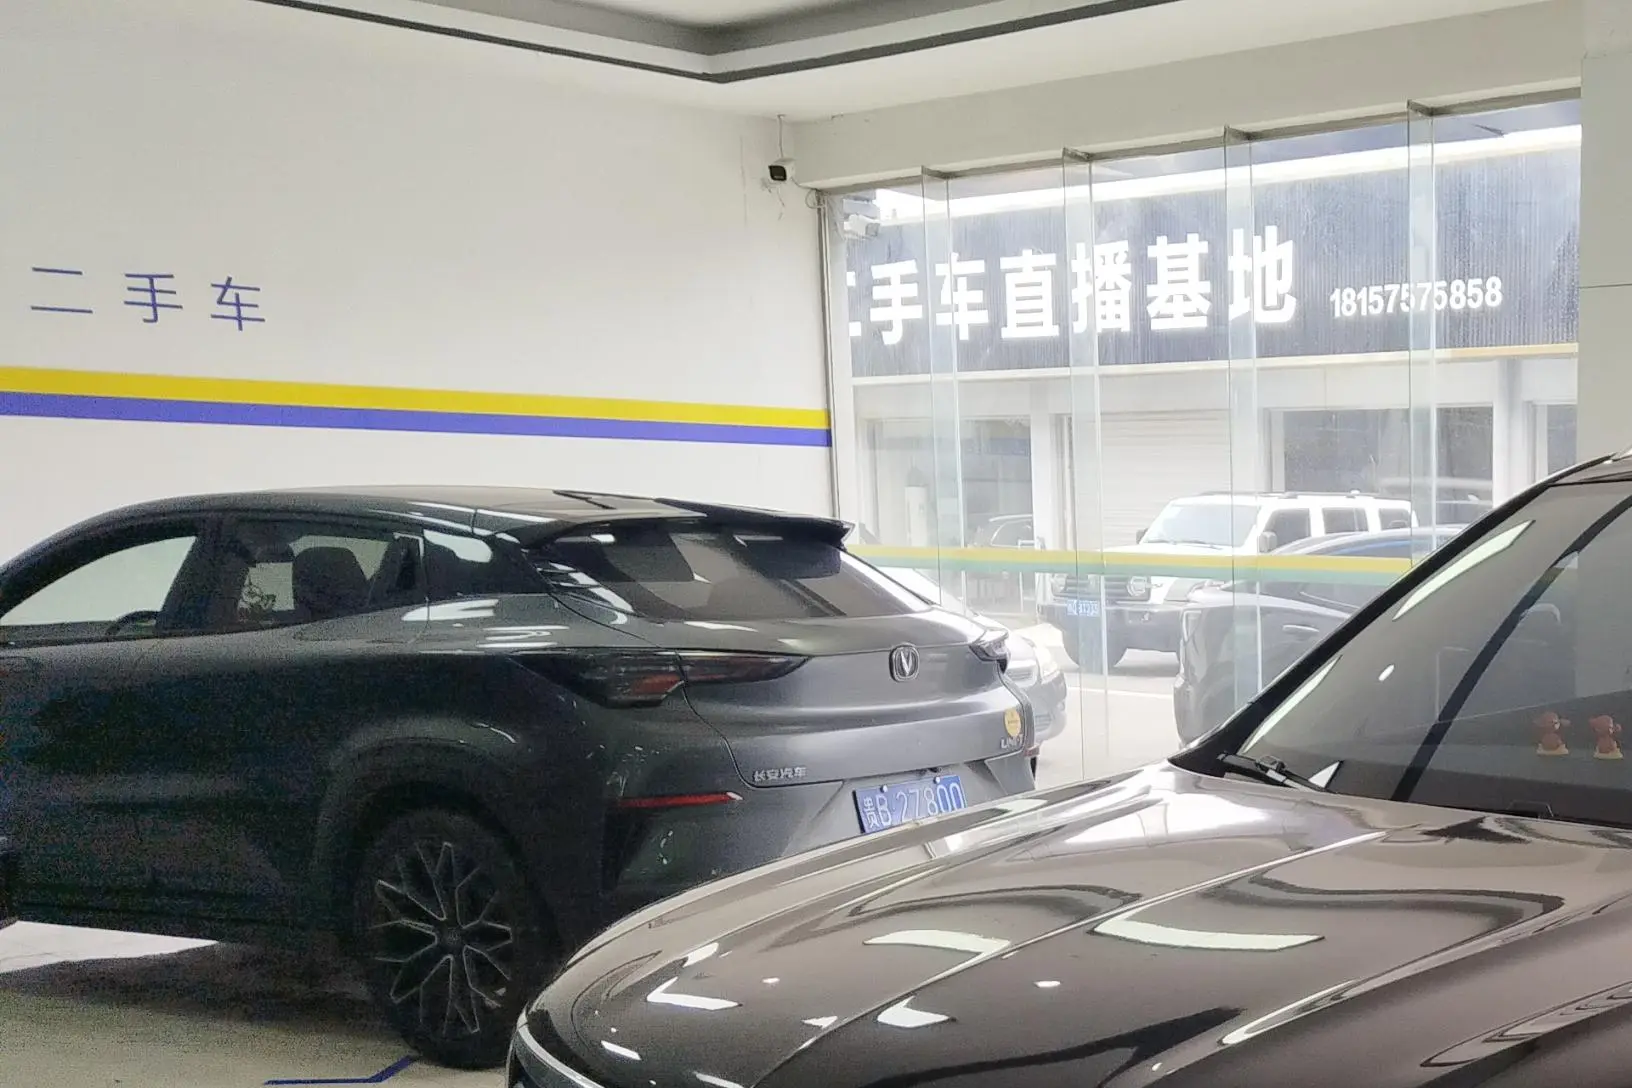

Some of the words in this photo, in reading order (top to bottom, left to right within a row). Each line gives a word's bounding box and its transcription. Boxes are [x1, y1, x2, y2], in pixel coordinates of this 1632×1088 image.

[31, 266, 266, 332] 二手车
[847, 225, 1297, 345] 手车直播基地
[1330, 276, 1503, 318] 18157575858
